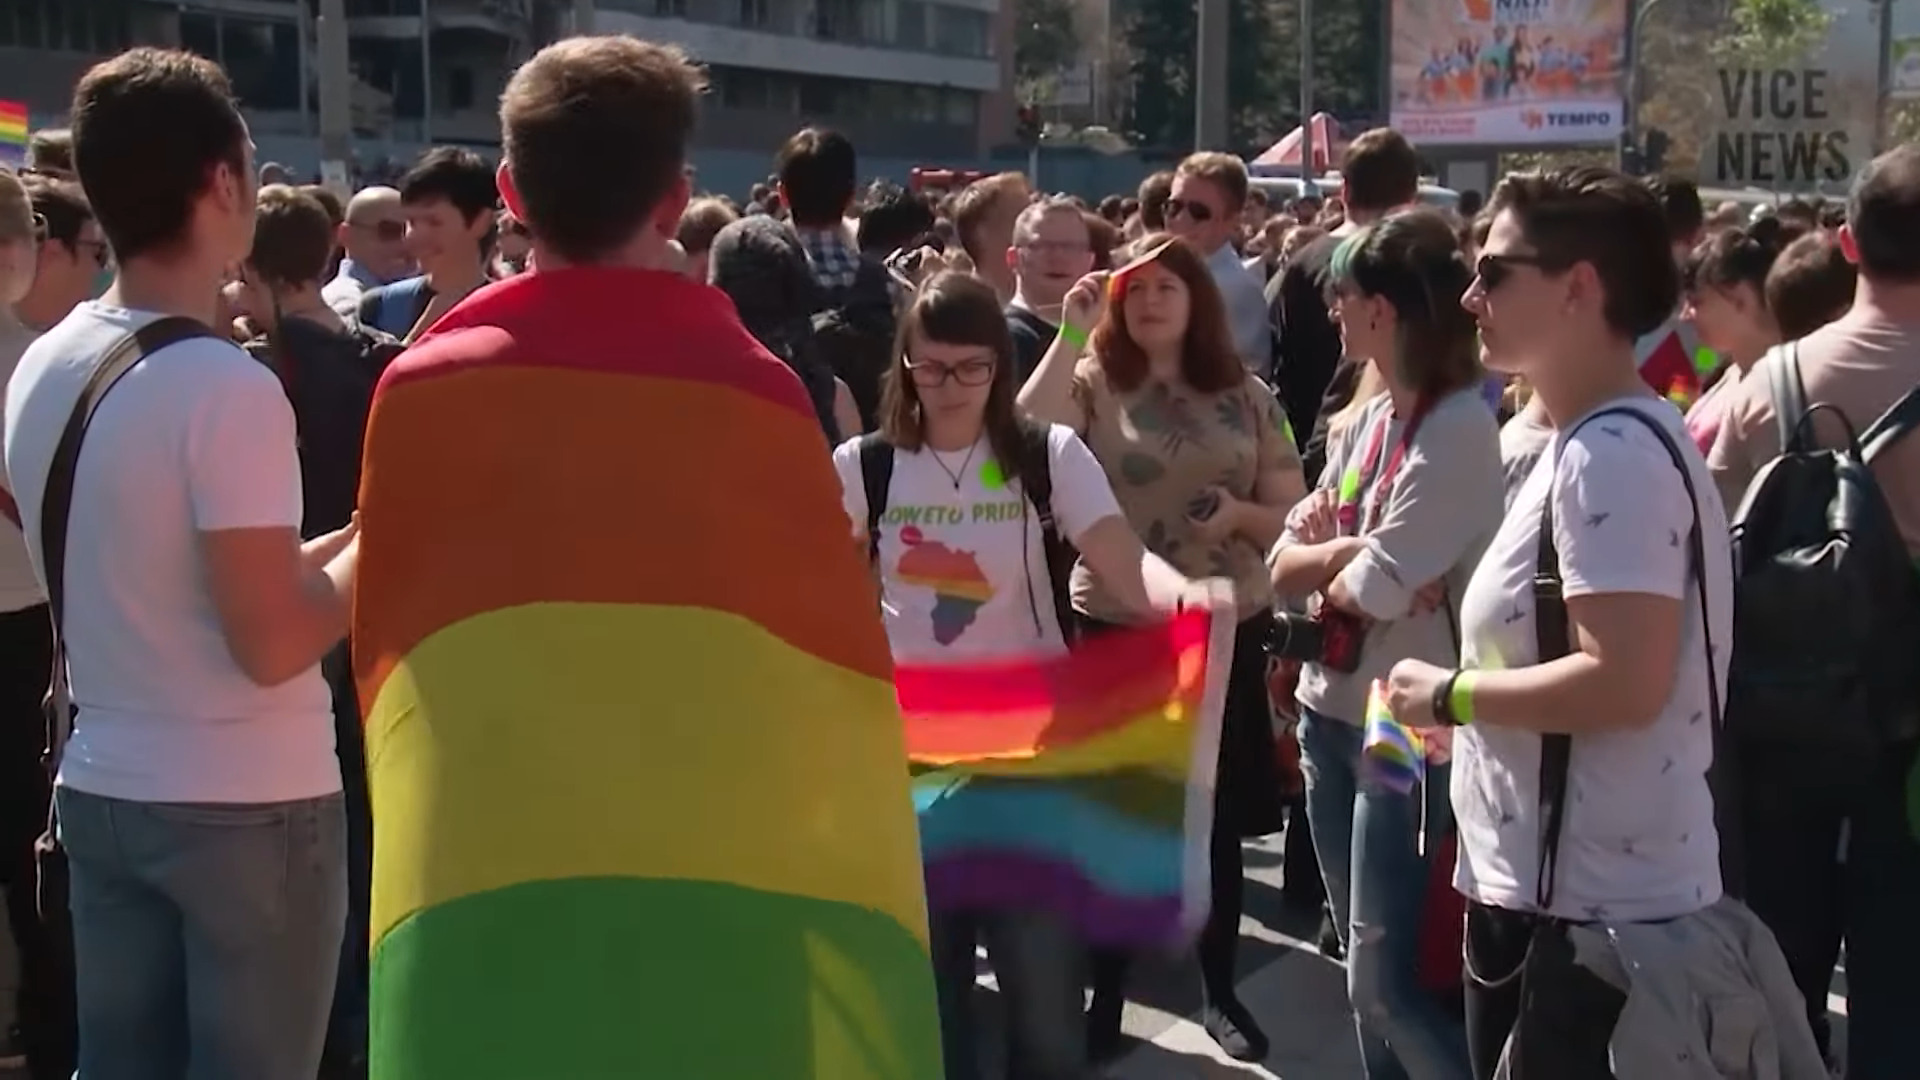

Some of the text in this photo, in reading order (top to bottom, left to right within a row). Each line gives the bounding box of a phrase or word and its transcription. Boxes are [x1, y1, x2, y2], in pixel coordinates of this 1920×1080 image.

[1547, 111, 1611, 127] TEMPO
[881, 501, 1025, 525] OWETO PRID
